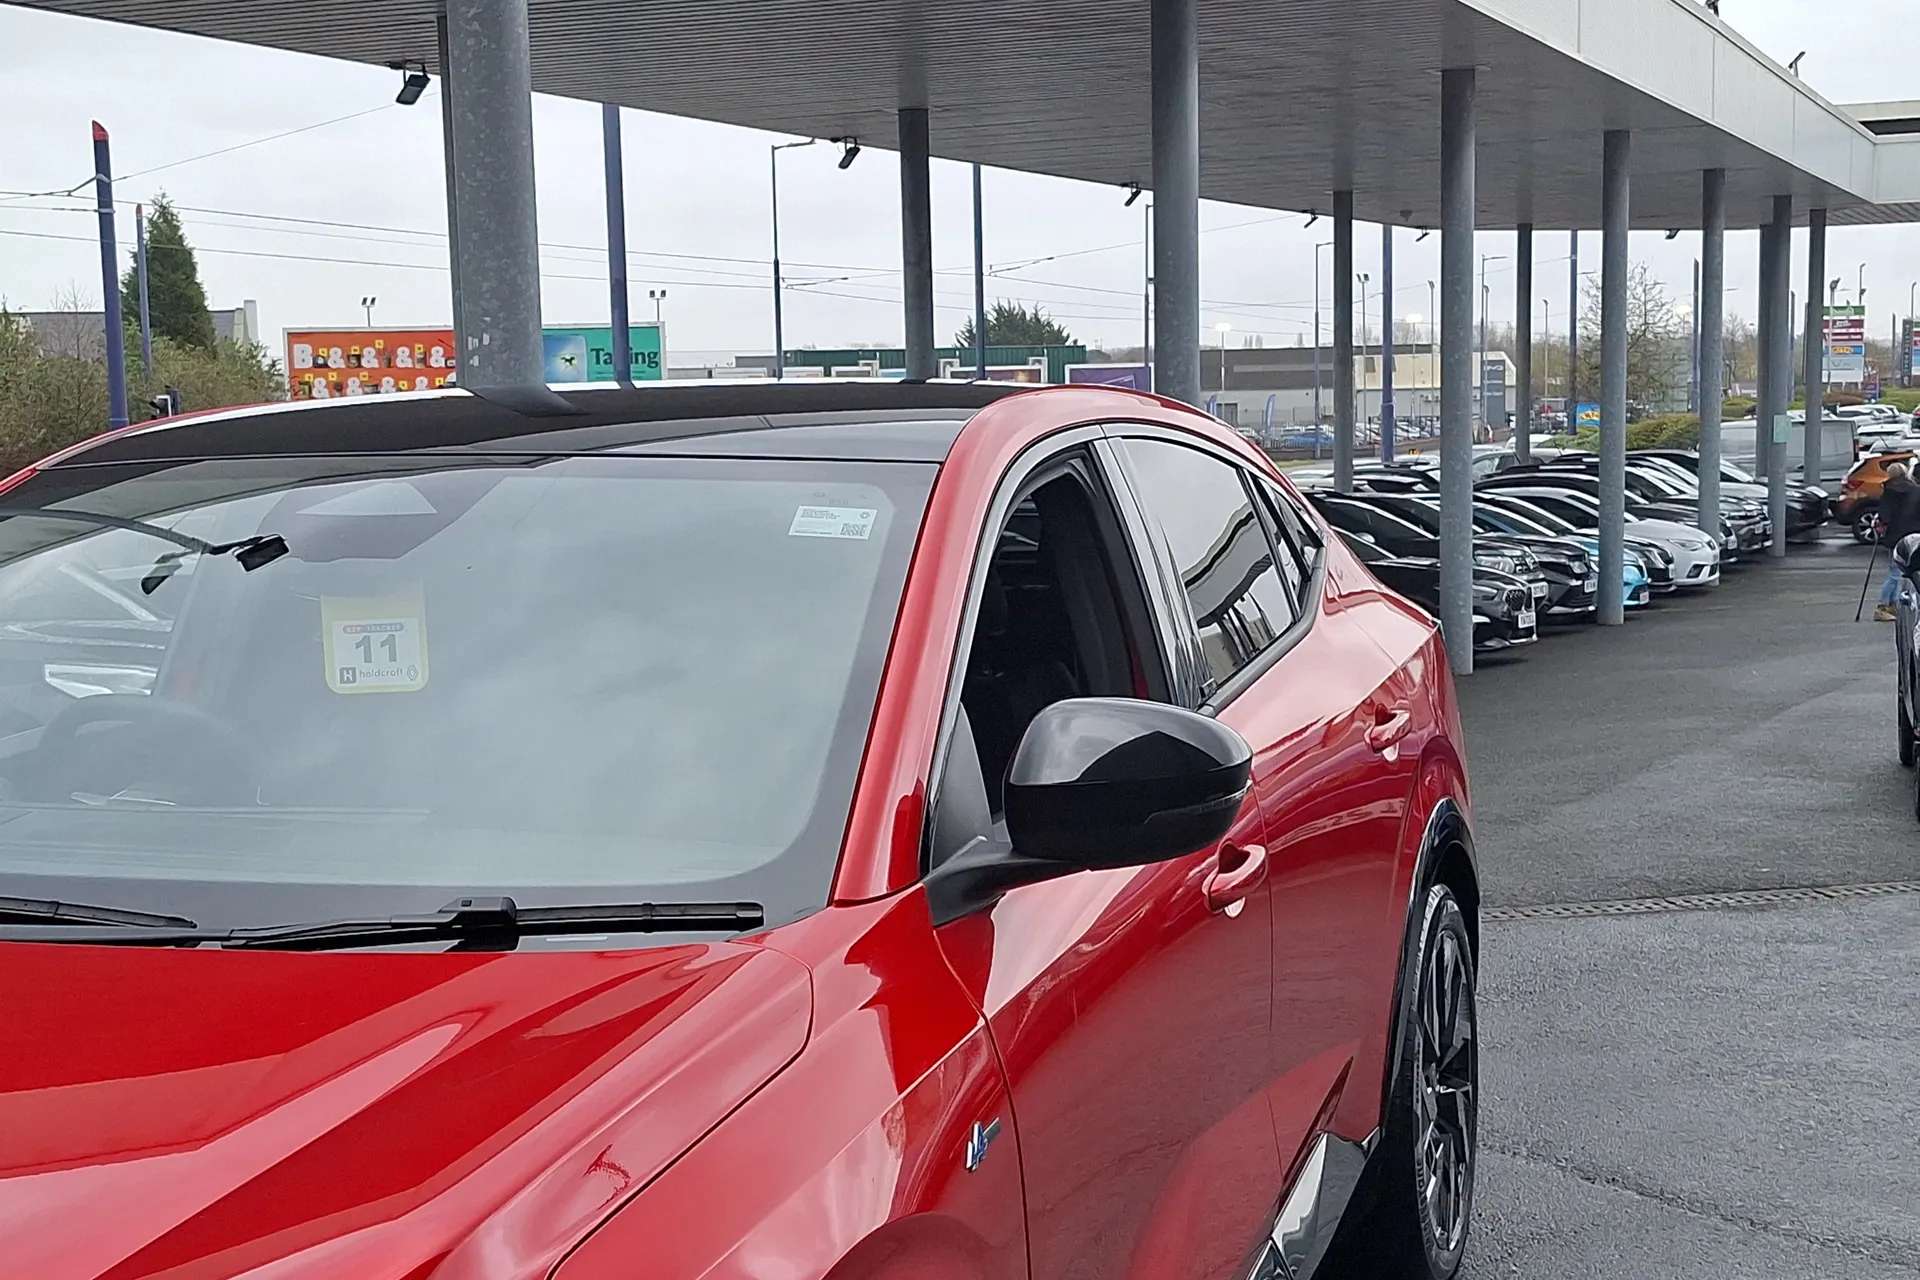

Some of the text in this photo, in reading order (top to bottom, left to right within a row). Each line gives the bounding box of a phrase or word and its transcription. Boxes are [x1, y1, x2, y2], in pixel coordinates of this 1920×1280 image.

[294, 343, 313, 369] B
[590, 347, 659, 369] Taing
[354, 634, 397, 664] 11
[341, 668, 355, 682] H
